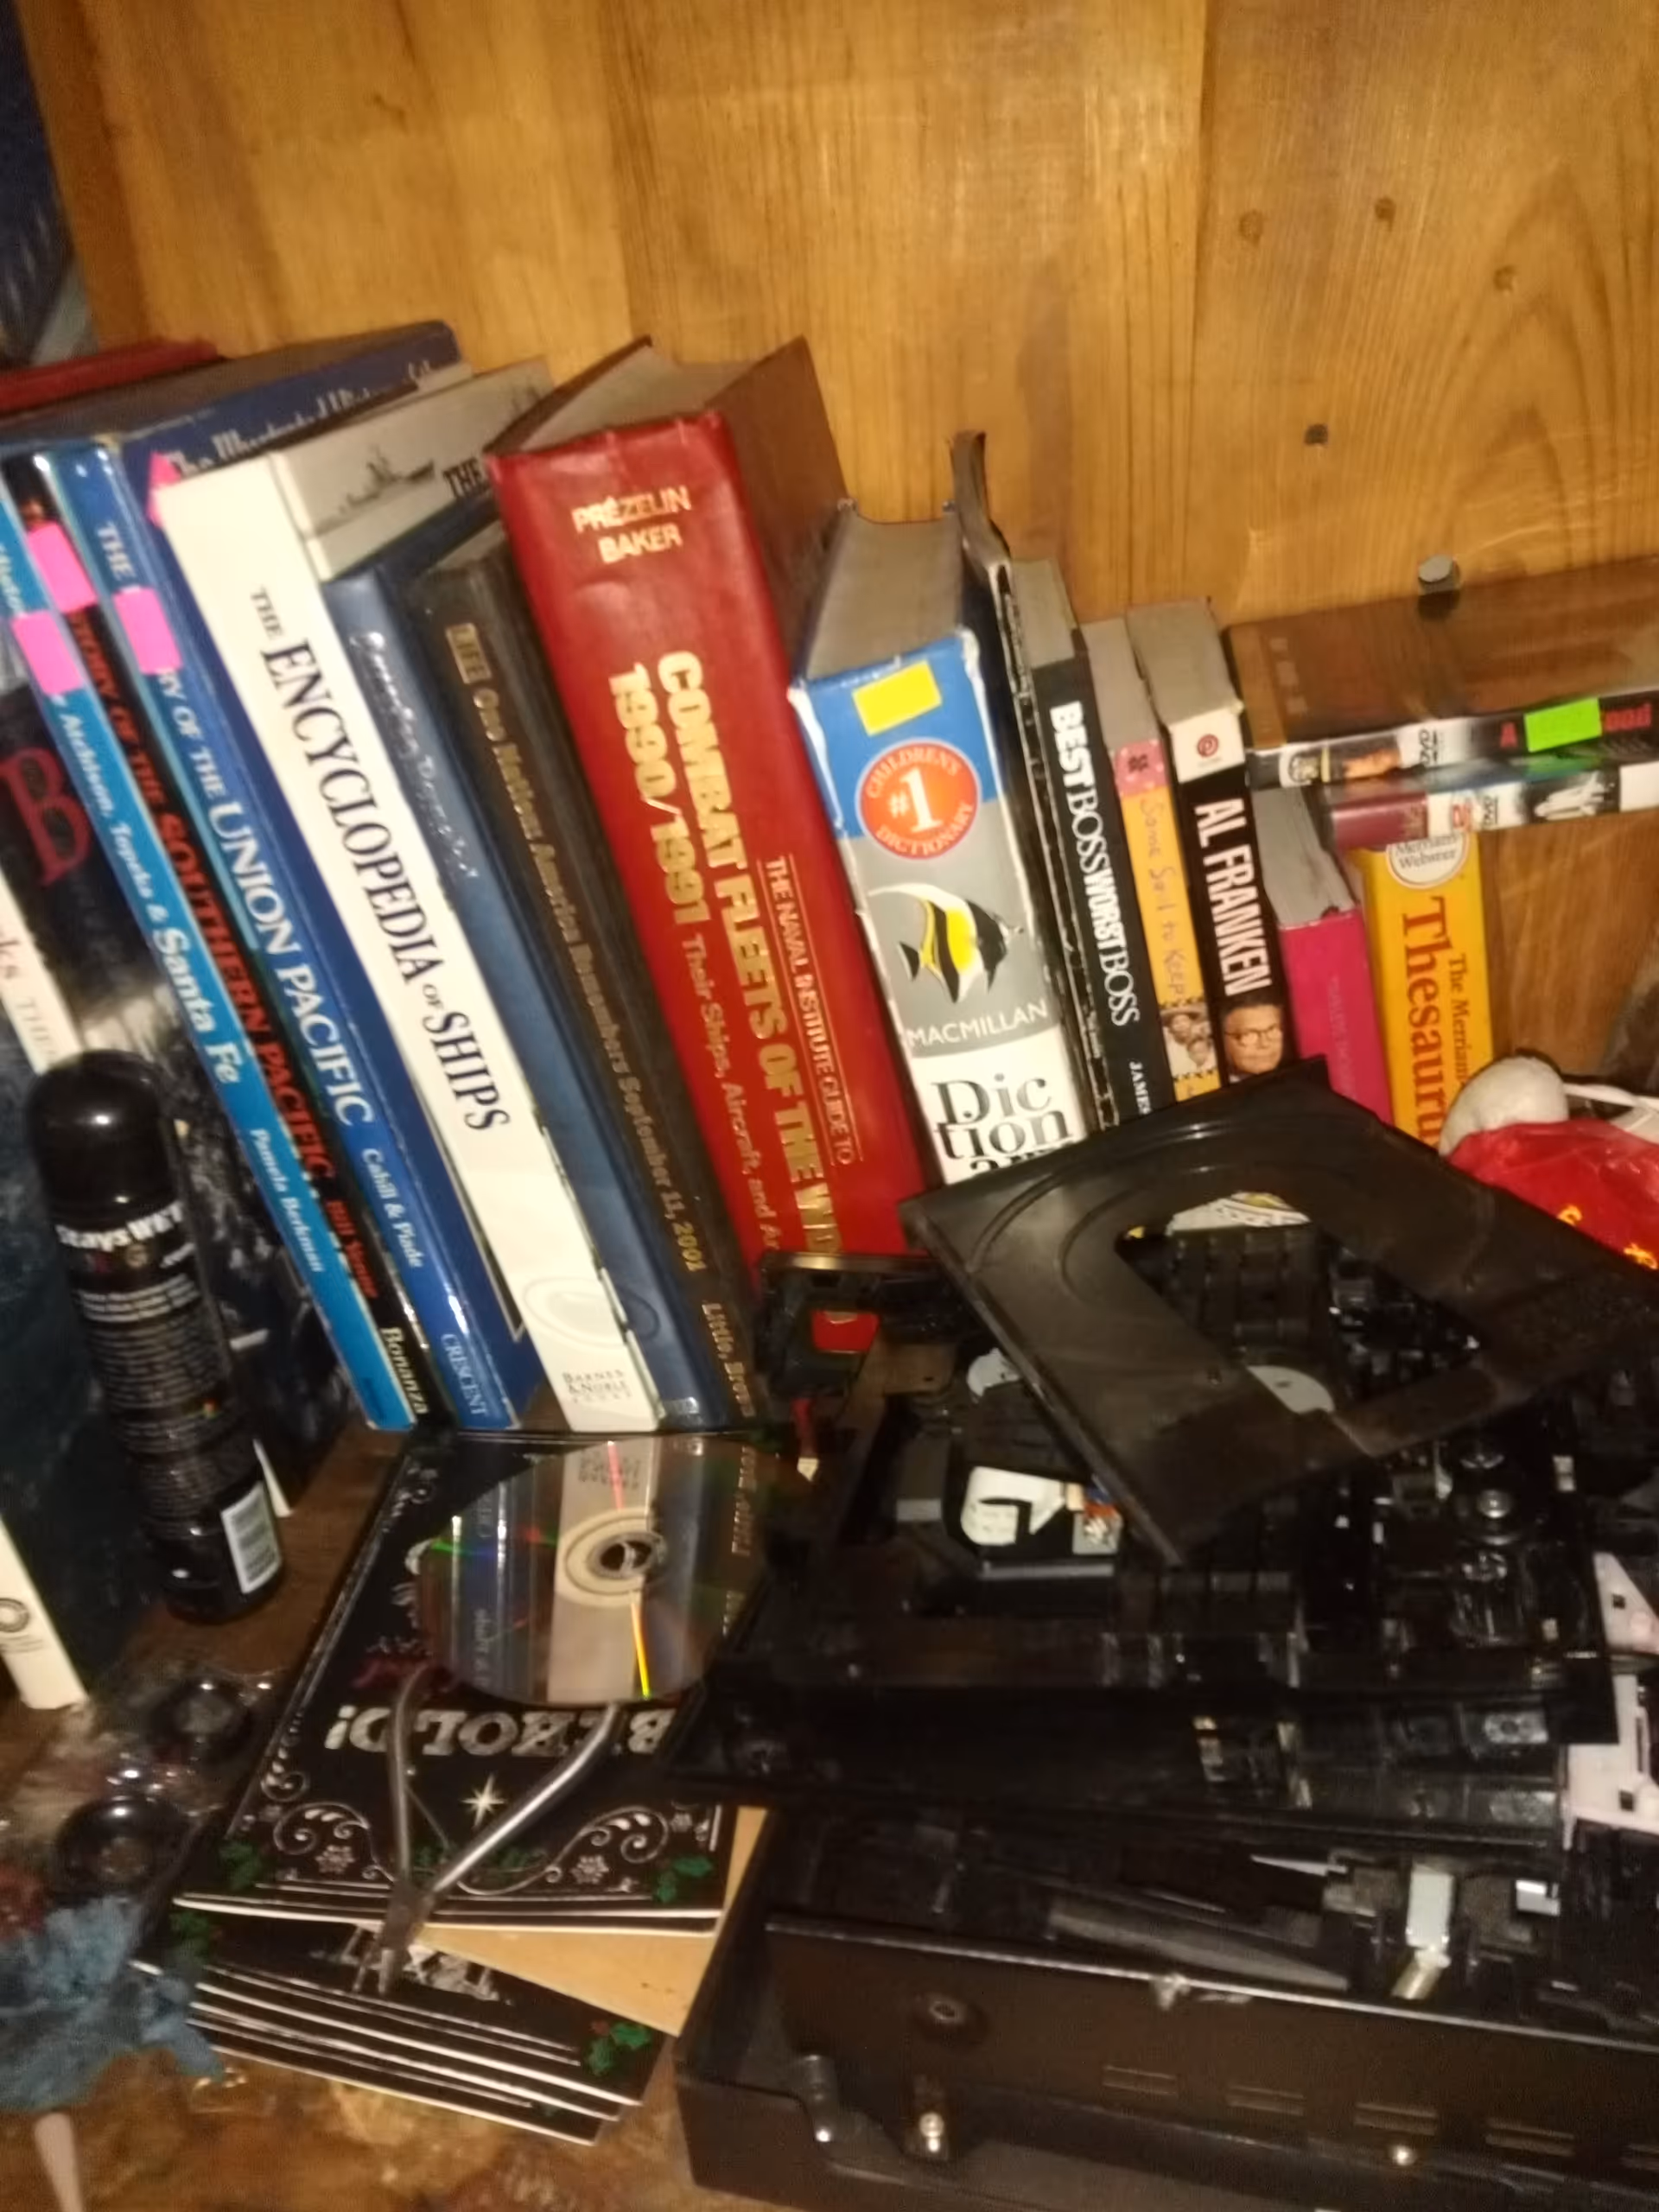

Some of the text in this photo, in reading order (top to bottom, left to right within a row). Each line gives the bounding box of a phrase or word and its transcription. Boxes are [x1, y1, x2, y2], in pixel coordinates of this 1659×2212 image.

[97, 520, 137, 581] THE
[598, 522, 683, 564] BAKER
[251, 585, 285, 642] THE
[657, 650, 748, 871] COMBAT
[1050, 701, 1096, 788] BEST
[261, 638, 445, 985] ENCYCLOPEDIA
[888, 766, 944, 833] #1
[1067, 781, 1110, 874] BOSS
[1193, 798, 1247, 849] AL
[608, 662, 711, 925] 1990/1991
[680, 932, 714, 1001] Their
[700, 1001, 731, 1079] Ships,
[721, 1082, 764, 1176] Aircraft,
[747, 1178, 778, 1227] and
[714, 874, 788, 1039] FLEETS
[1200, 846, 1274, 997] FRANKEN
[764, 856, 857, 1166] THE NAVAL INSTITUTE GUIDE TO
[1100, 942, 1141, 1027] BOSS
[1448, 953, 1467, 995] The
[111, 823, 154, 899] Topeka
[152, 928, 217, 1034] Santa
[204, 1042, 245, 1084] Fe
[279, 1196, 327, 1274] Berkman
[173, 697, 203, 741] OF
[189, 747, 227, 799] THE
[209, 802, 302, 956] UNION
[275, 963, 374, 1127] PACIFIC
[362, 1147, 398, 1198] Cahill
[439, 1333, 491, 1417] CRESCENT
[906, 999, 1048, 1047] MACMILLAN
[1402, 895, 1453, 1149] Thesauru
[158, 812, 271, 1037] SOUTHERN
[257, 1039, 337, 1179] PACIFIC
[380, 1327, 429, 1414] Bonanza
[422, 1009, 511, 1132] SHIPS
[757, 1043, 805, 1098] OF
[931, 1072, 1052, 1124] Dic
[618, 1076, 671, 1195] September
[673, 1222, 709, 1273] 2001
[774, 1099, 824, 1184] THE
